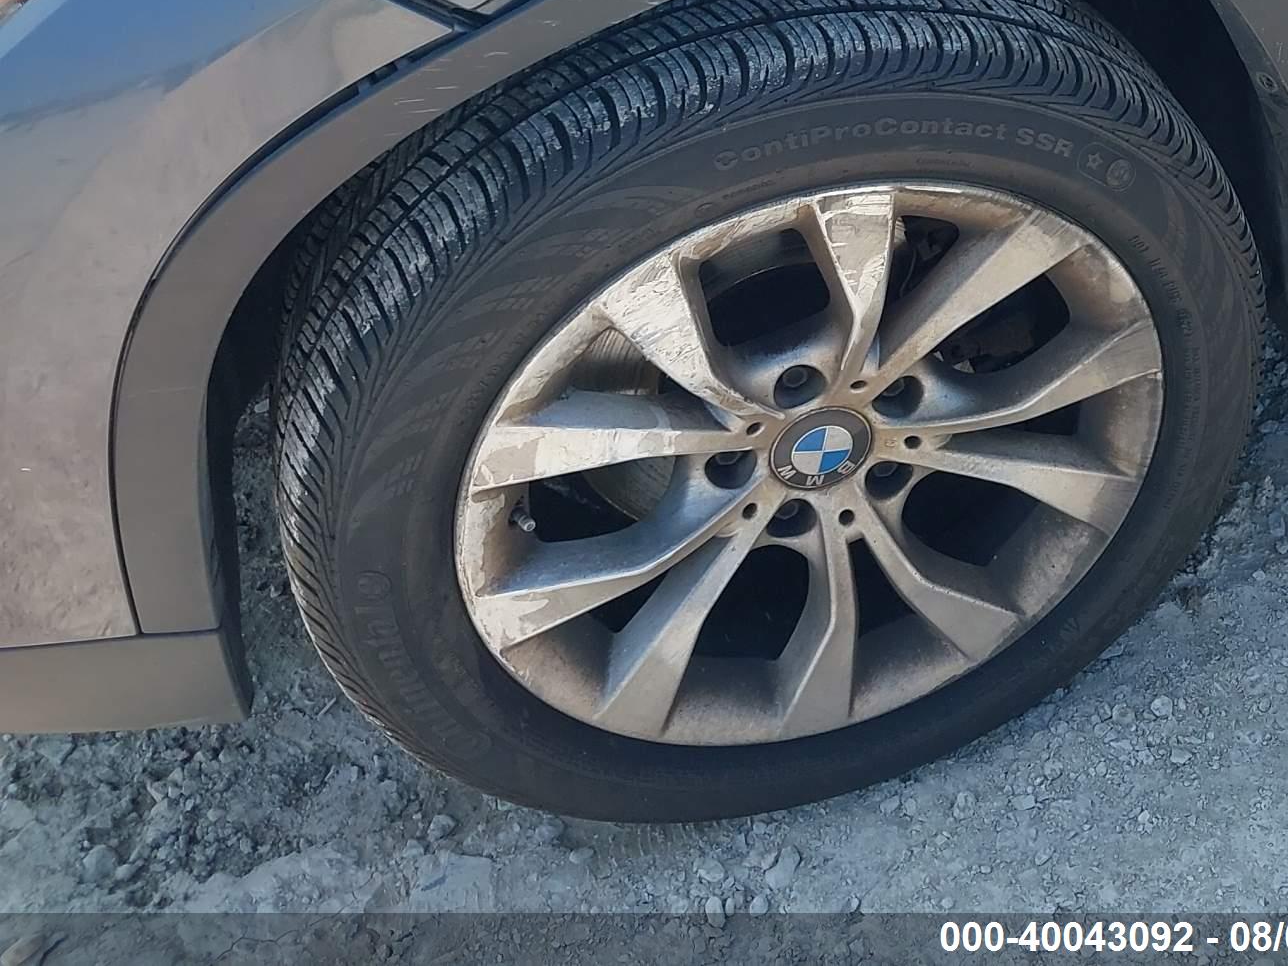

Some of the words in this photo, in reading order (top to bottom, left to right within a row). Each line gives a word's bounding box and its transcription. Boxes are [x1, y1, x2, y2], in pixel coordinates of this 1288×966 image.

[713, 115, 1005, 171] ContiProContact
[1016, 128, 1076, 158] SSR
[777, 460, 857, 486] BMW
